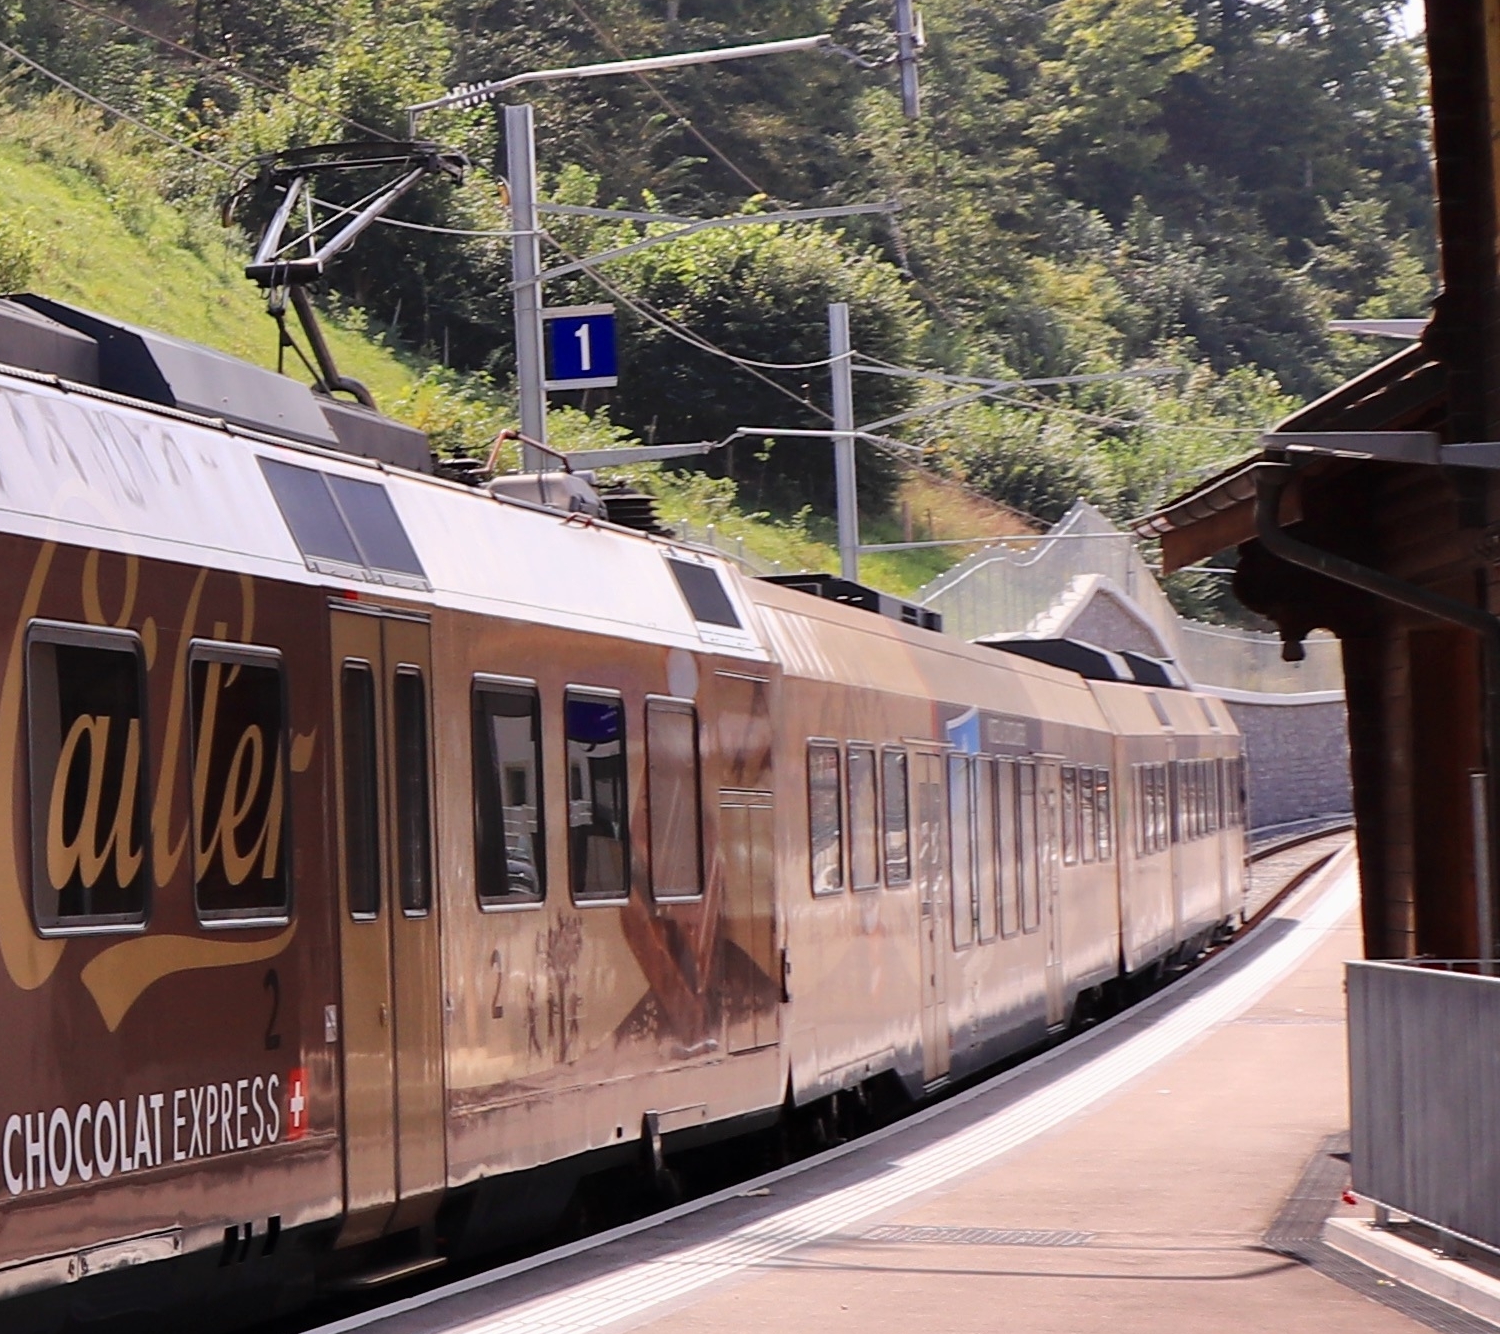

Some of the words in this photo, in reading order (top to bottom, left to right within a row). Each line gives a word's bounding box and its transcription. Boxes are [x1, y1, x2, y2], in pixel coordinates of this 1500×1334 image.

[574, 323, 591, 371] 1
[263, 968, 281, 1050] 2
[2, 1093, 165, 1196] CHOCOLAT
[173, 1073, 281, 1162] EXPRESS
